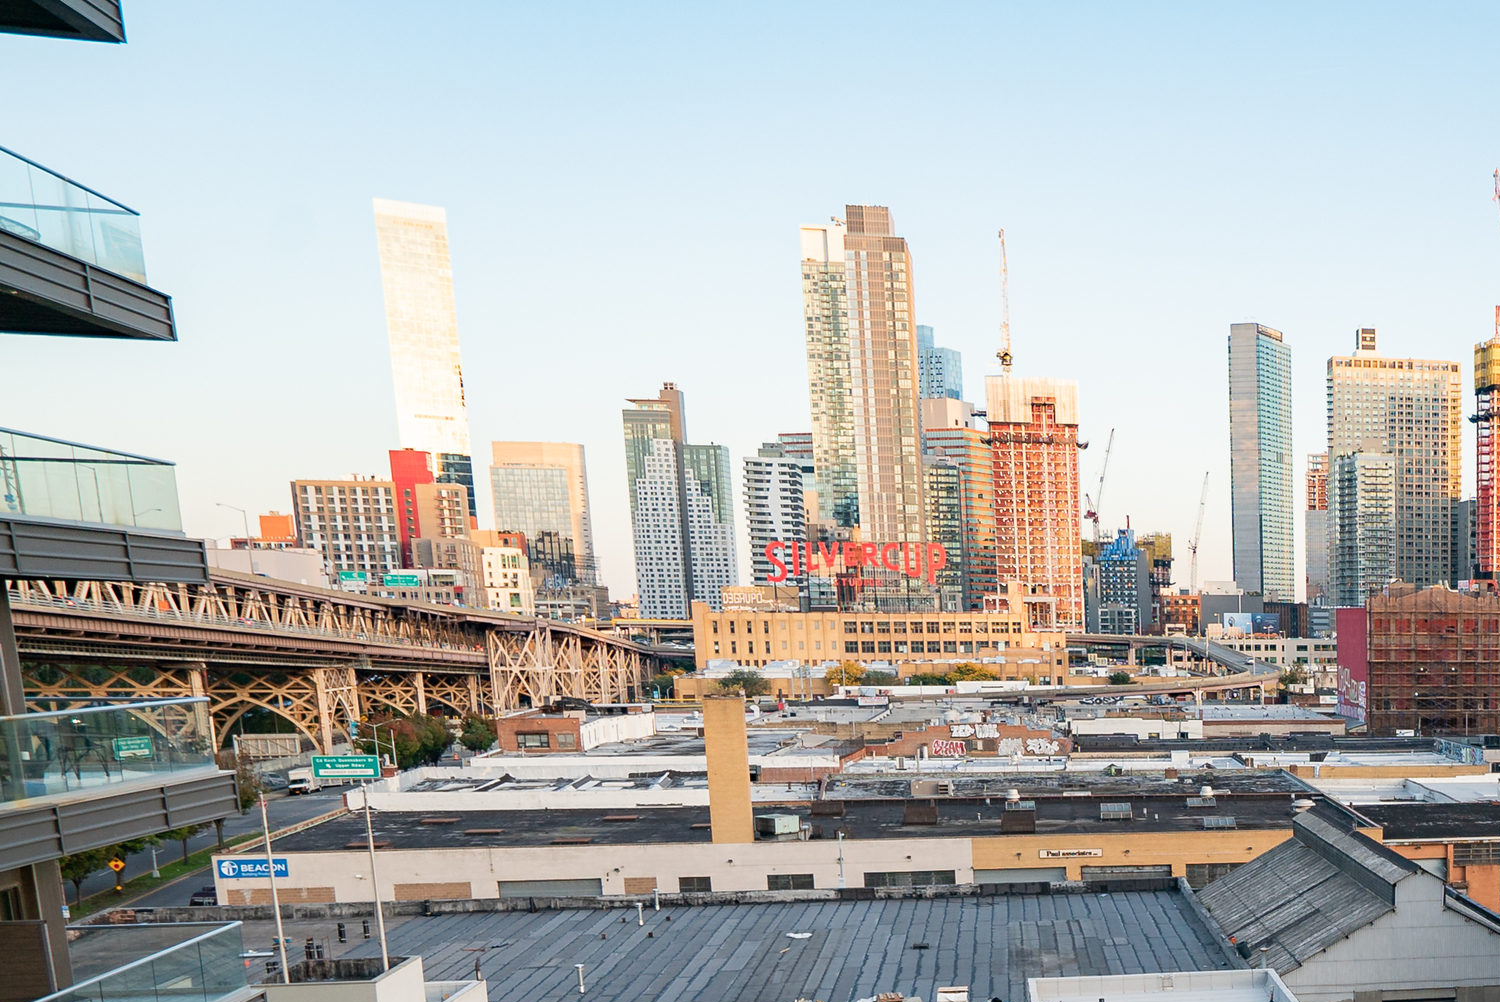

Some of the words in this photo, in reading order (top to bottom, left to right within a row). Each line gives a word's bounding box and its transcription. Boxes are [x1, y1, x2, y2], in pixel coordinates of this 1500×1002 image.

[764, 541, 947, 586] SILVERCUP
[832, 577, 883, 588] STUDIOS
[240, 863, 286, 872] BEACON
